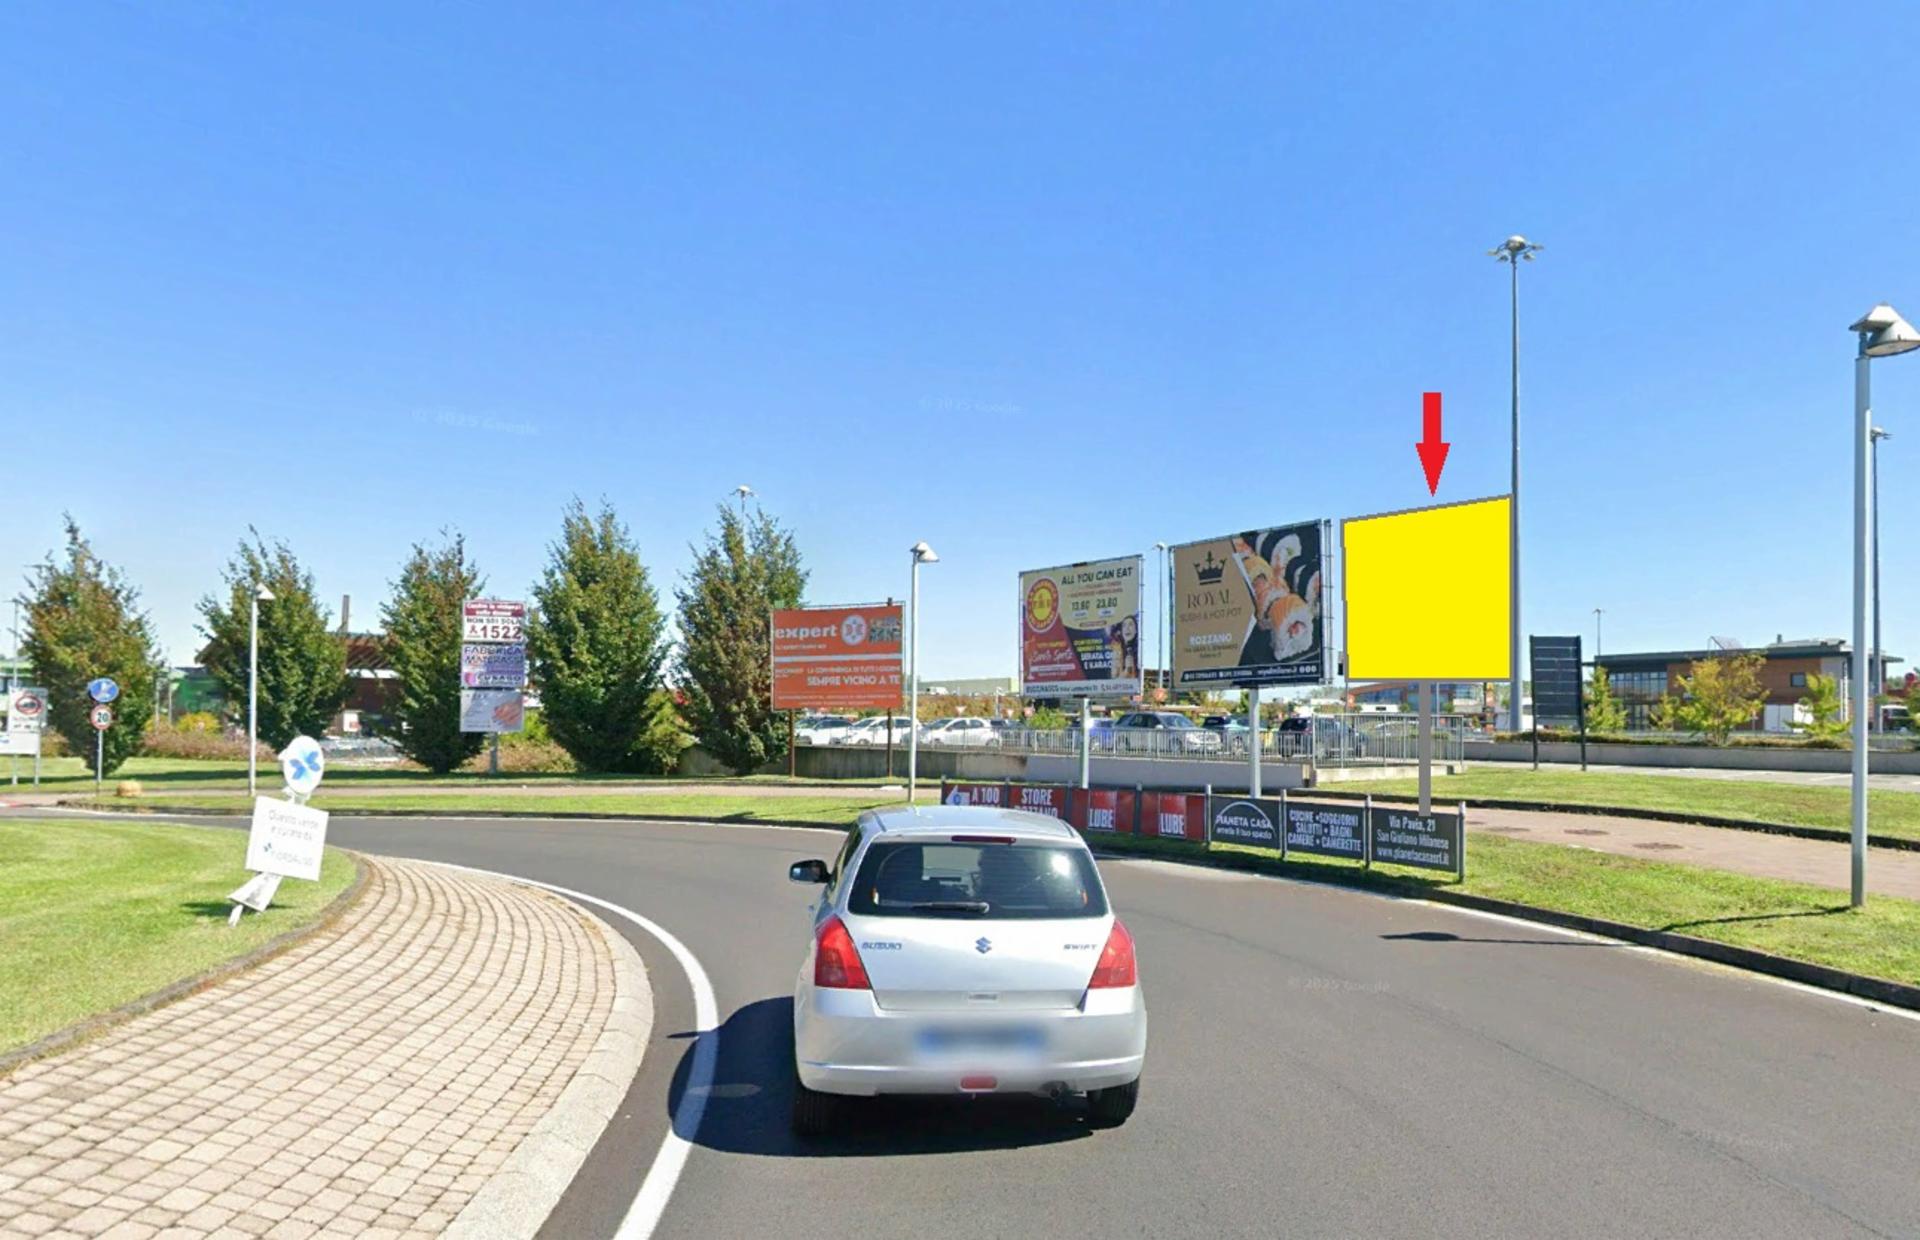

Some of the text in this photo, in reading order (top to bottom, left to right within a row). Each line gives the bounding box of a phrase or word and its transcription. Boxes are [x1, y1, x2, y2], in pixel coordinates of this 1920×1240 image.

[1061, 575, 1075, 585] ALL
[1077, 572, 1094, 583] YOU
[1096, 569, 1115, 581] CAN
[1116, 566, 1133, 577] EAT
[1187, 588, 1230, 608] ROYAL
[480, 625, 522, 640] 1522
[775, 624, 838, 641] expert
[807, 675, 841, 686] SEMPRE
[843, 675, 877, 685] VICINO
[889, 674, 901, 684] TE
[971, 787, 1000, 804] A 100
[1021, 788, 1053, 805] STORE
[1088, 808, 1114, 828] LUBE
[1160, 813, 1185, 834] LUBE
[1216, 814, 1273, 830] PIANETA CASA
[1289, 810, 1314, 823] CUCINE
[1389, 815, 1400, 829] Via
[1295, 821, 1353, 838] SALOTTI BAGNI
[1287, 832, 1362, 852] CAMERE CAMERETTE
[1376, 828, 1449, 849] San Giuliano Milanese
[1063, 943, 1098, 951] SWIFT
